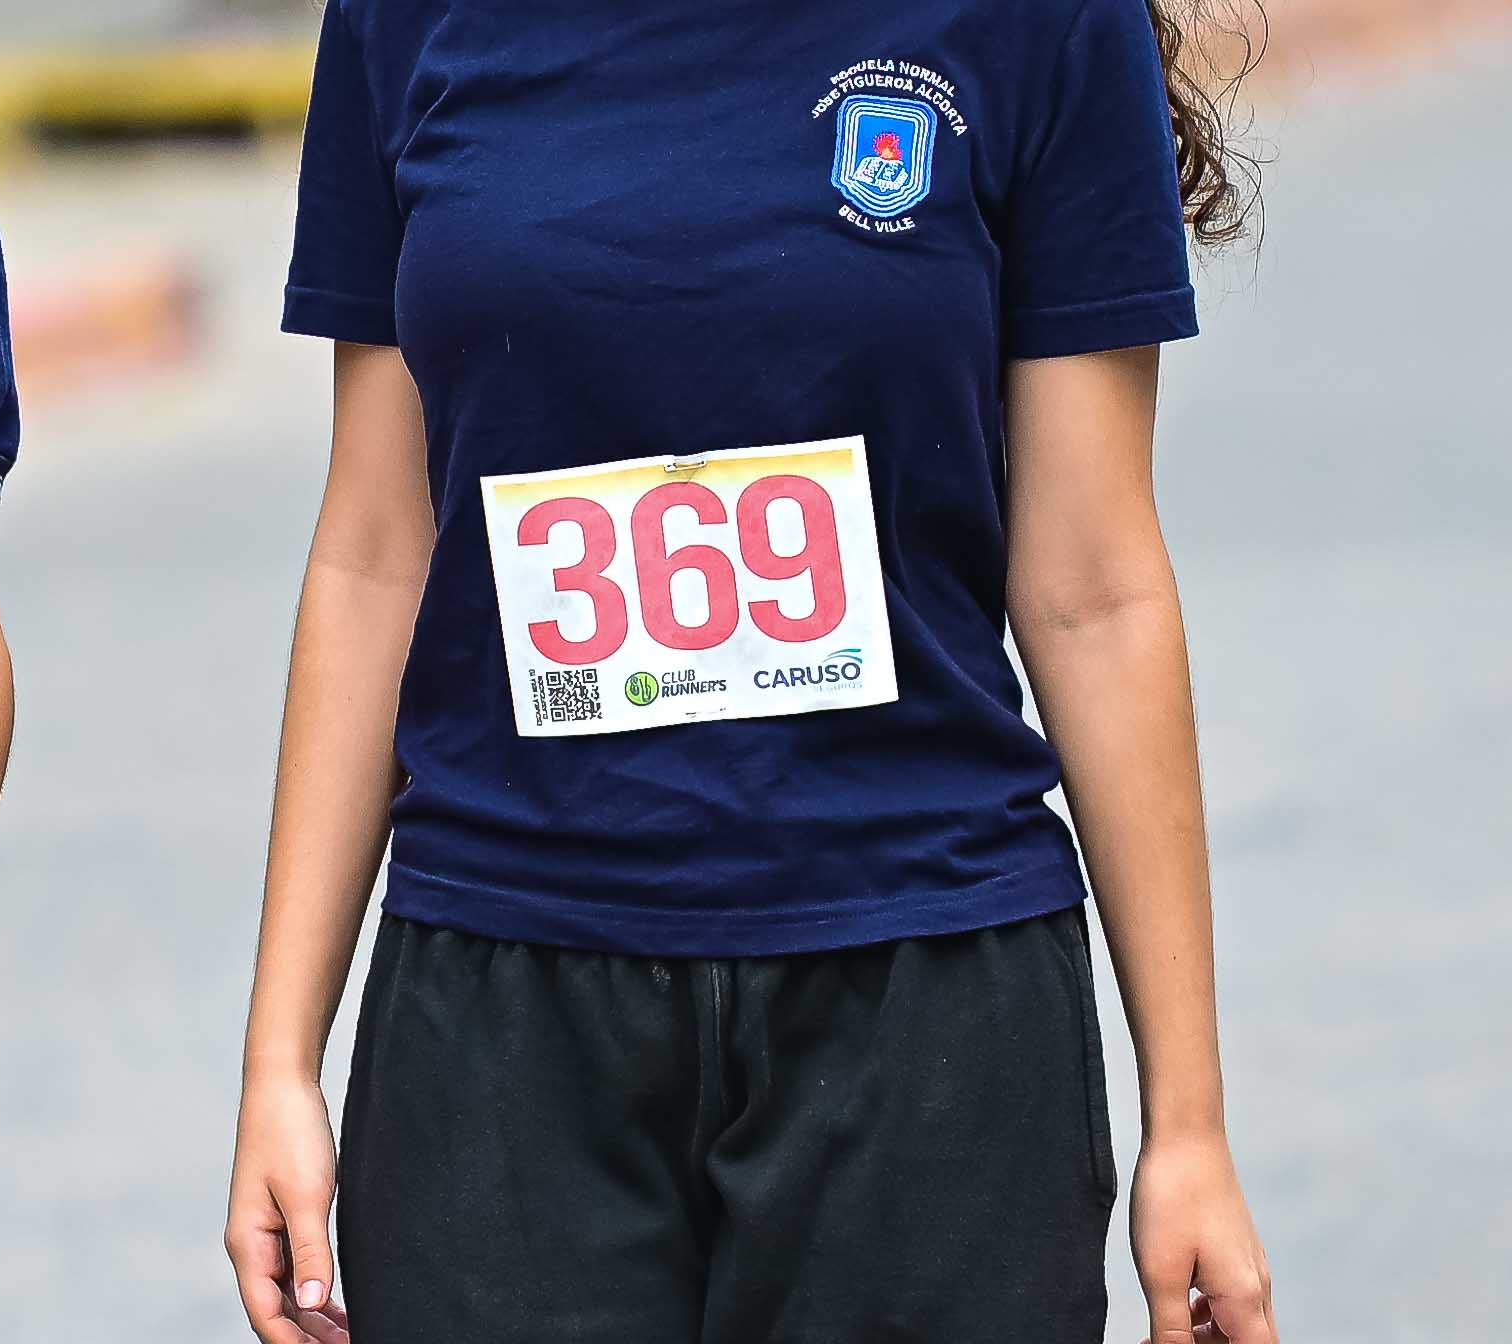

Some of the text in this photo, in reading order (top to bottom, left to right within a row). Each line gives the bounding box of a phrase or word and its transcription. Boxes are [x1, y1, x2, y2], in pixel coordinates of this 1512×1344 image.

[899, 61, 957, 98] NORMAL
[839, 73, 914, 93] FIGUEROA
[915, 83, 968, 136] ALCORTA
[838, 204, 916, 232] BELL VILLE
[517, 474, 847, 665] 369
[661, 669, 696, 684] CLUB
[661, 680, 726, 698] RUNNER'S
[753, 662, 861, 689] CARUSO
